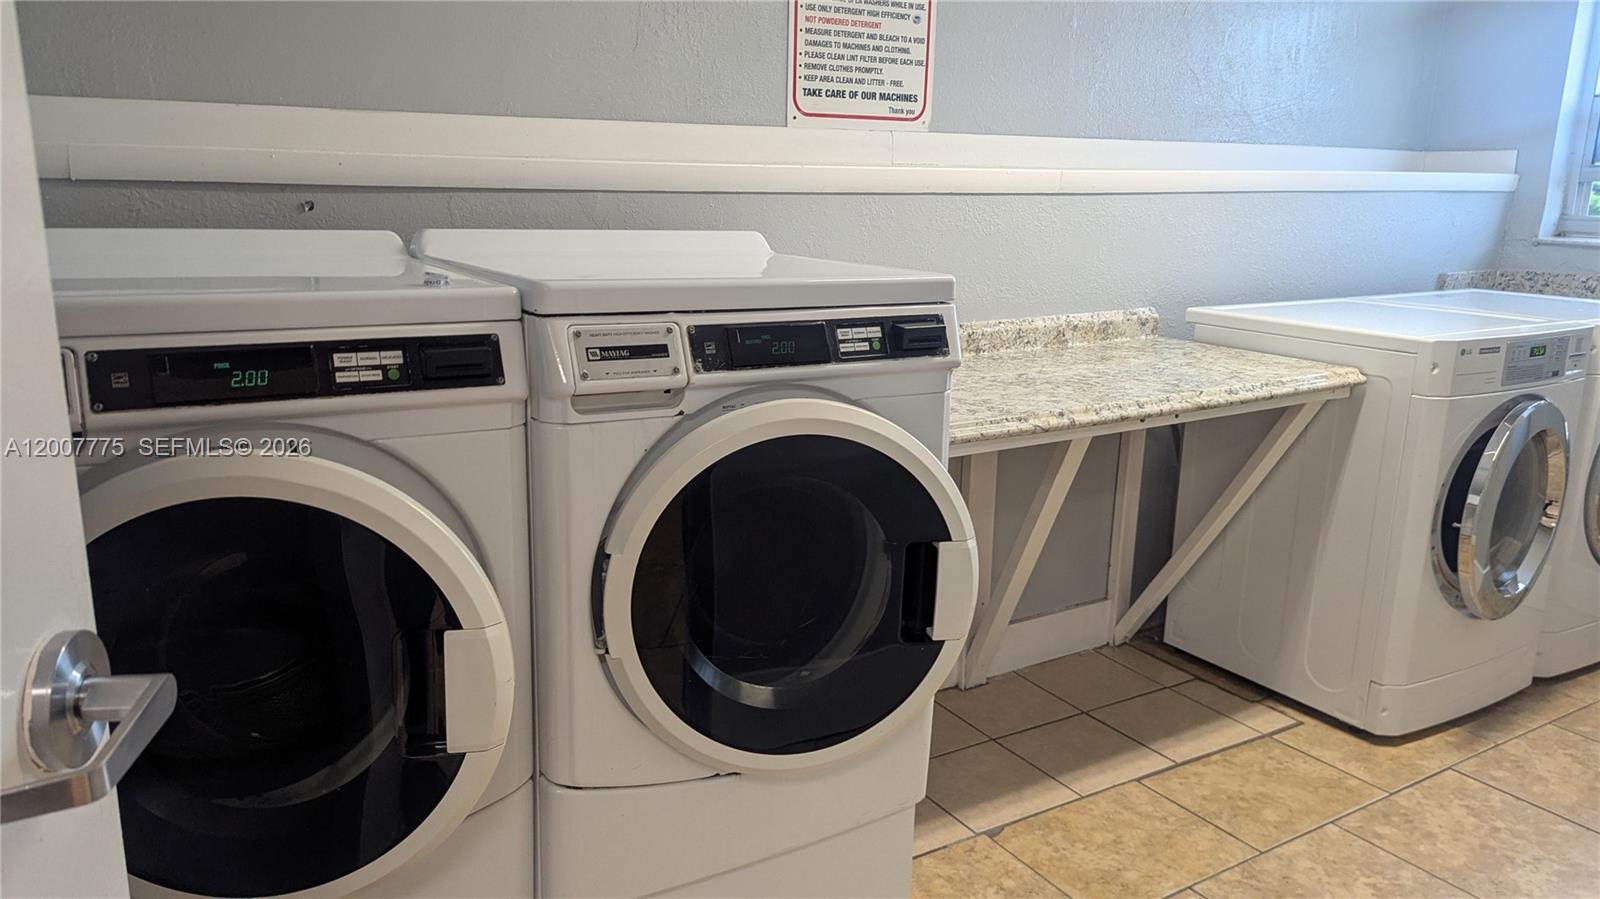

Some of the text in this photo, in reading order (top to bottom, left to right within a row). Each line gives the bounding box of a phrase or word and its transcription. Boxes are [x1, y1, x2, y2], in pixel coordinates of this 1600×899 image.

[834, 6, 865, 16] DETERGENT
[881, 11, 911, 20] EFFICIENCY
[818, 16, 849, 26] POWDERED
[851, 20, 882, 29] DETERGENT
[805, 27, 832, 36] MEASURE
[834, 30, 865, 38] DETERGENT
[879, 34, 900, 42] BLEACH
[804, 39, 832, 48] DAMAGES
[842, 42, 870, 51] MACHINES
[804, 50, 826, 59] PLEASE
[826, 52, 845, 60] CLEAN
[860, 55, 878, 63] FILTER
[879, 56, 898, 64] BEFORE
[804, 62, 884, 75] REMOVE CLOTHES PROMPTLY.
[802, 88, 918, 103] TAKE CARE OF OUR MACHINES
[601, 349, 630, 357] MAYTAG
[772, 341, 795, 354] 2.00
[231, 370, 268, 387] 2.00
